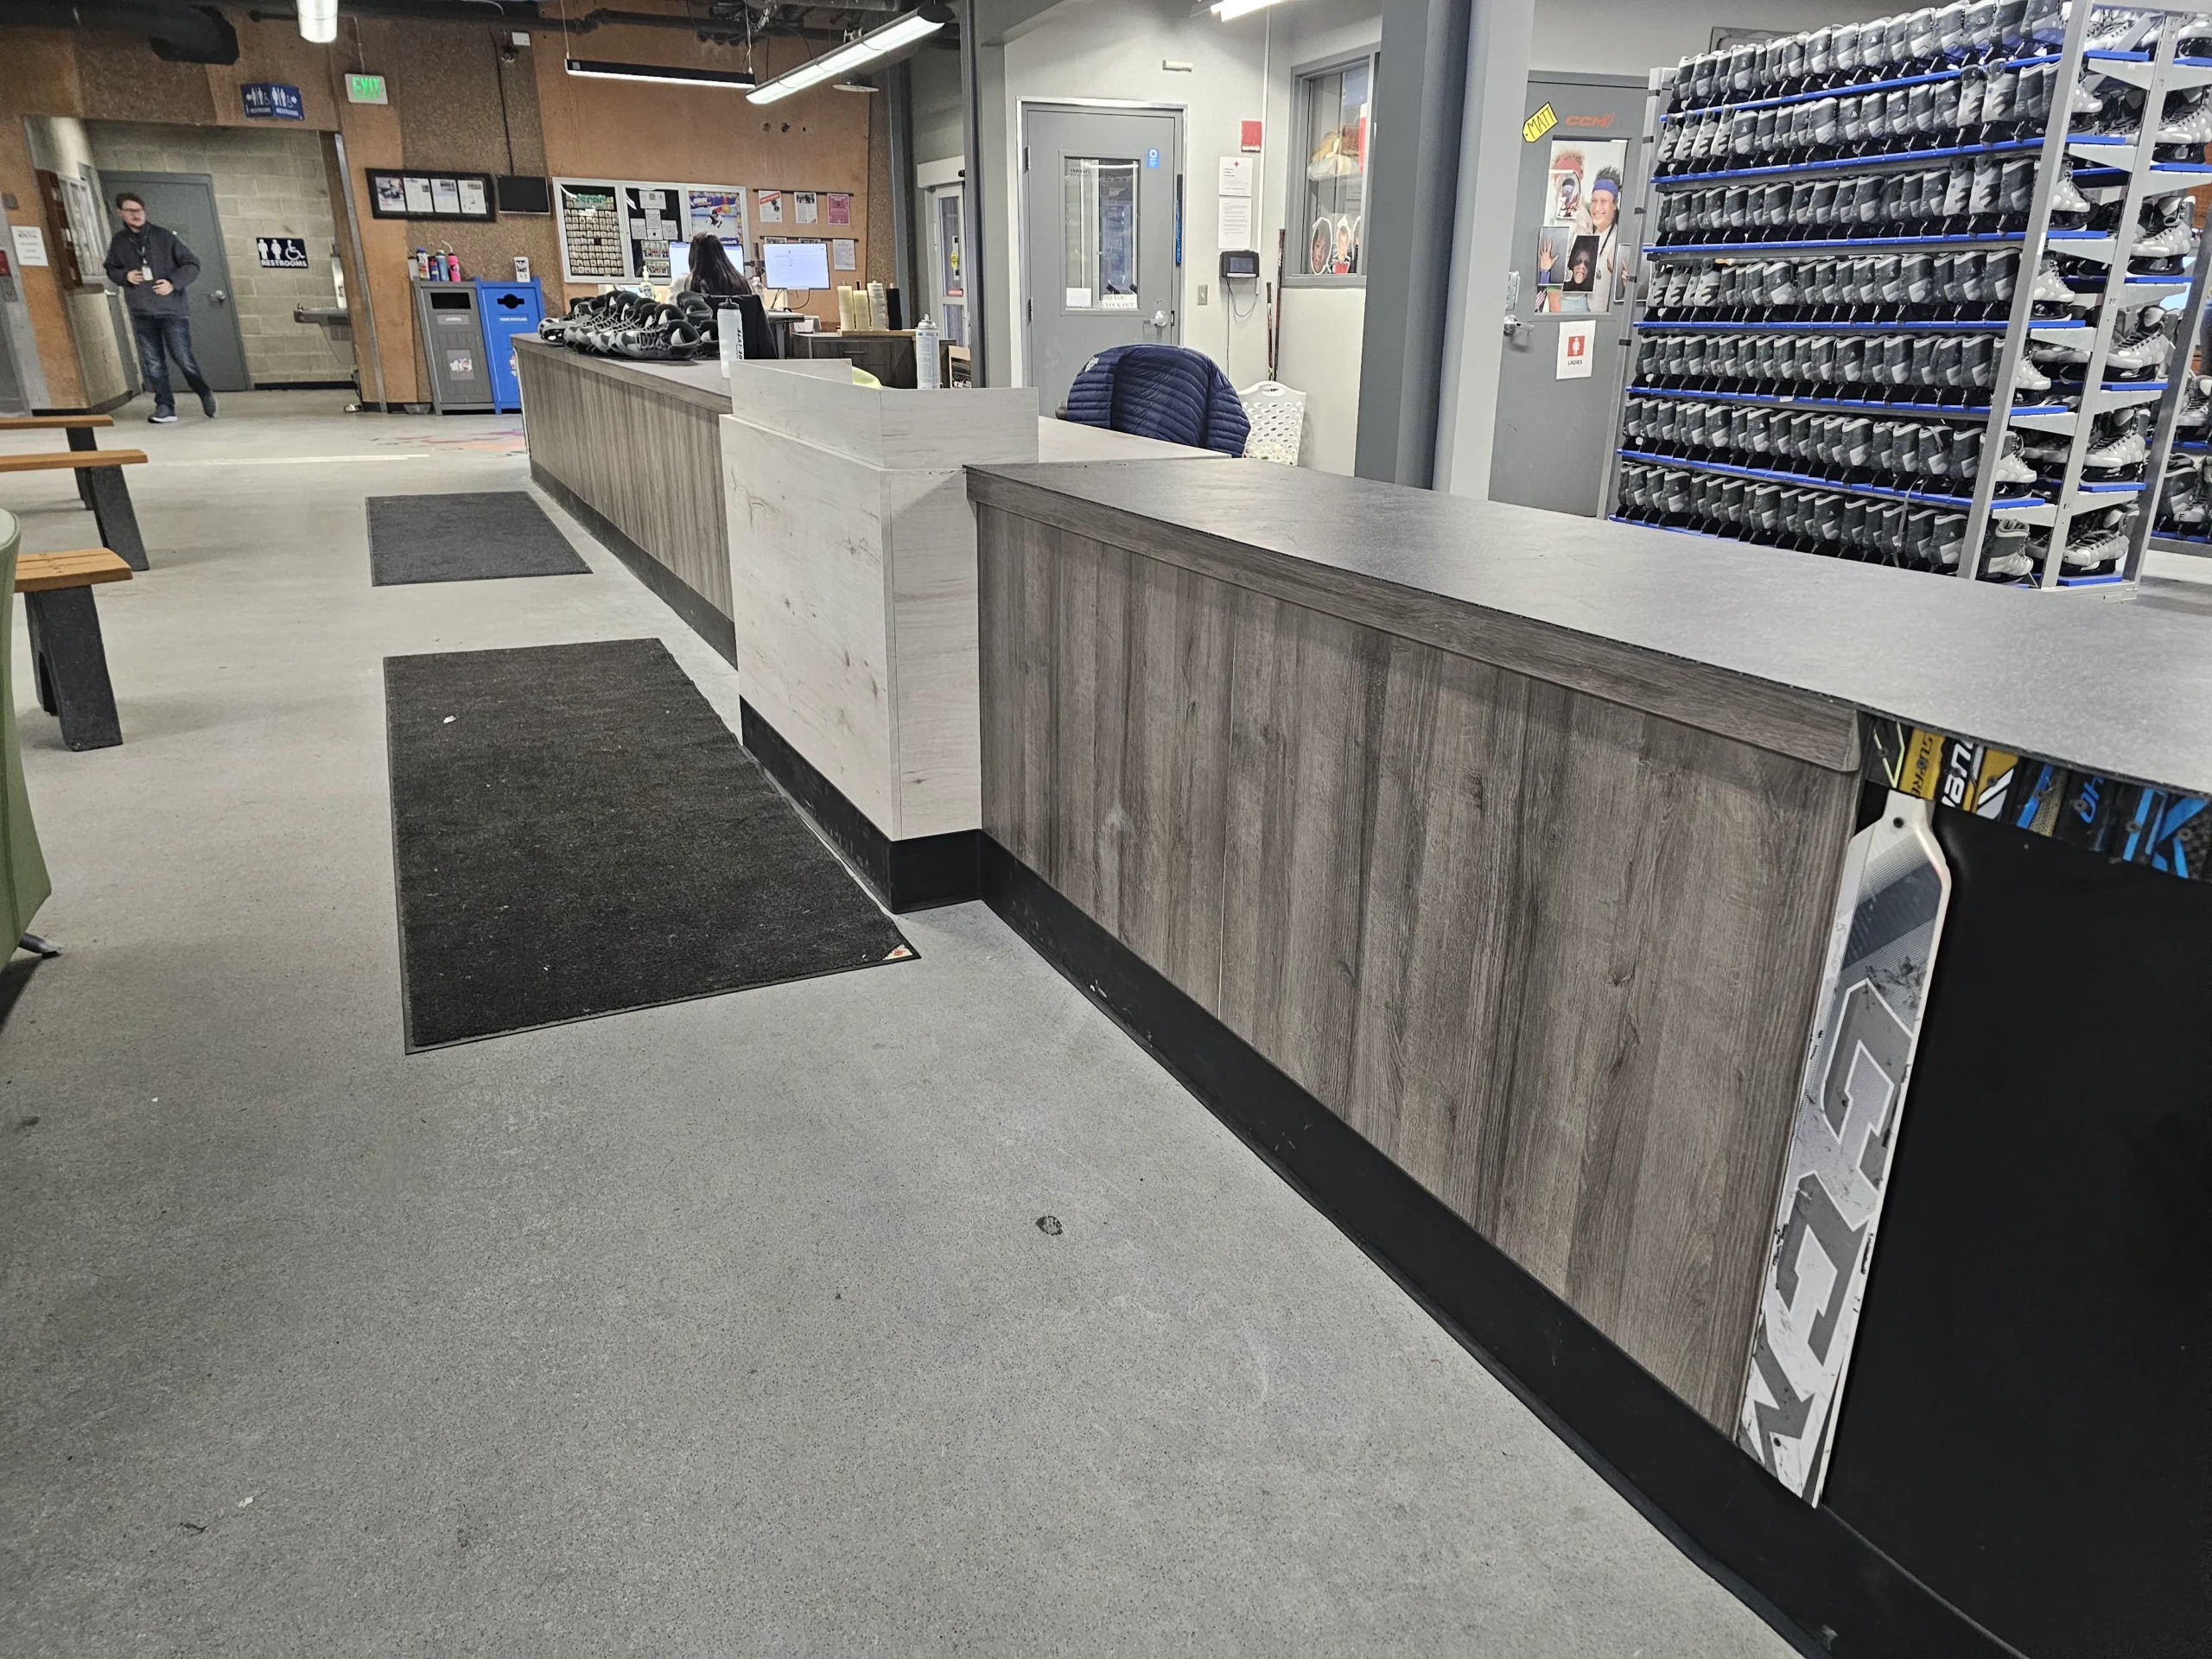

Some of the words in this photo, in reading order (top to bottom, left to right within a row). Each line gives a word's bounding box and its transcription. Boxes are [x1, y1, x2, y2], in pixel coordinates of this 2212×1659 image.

[352, 77, 380, 99] EXIT
[1527, 105, 1555, 139] MATT
[1566, 112, 1616, 128] CCM
